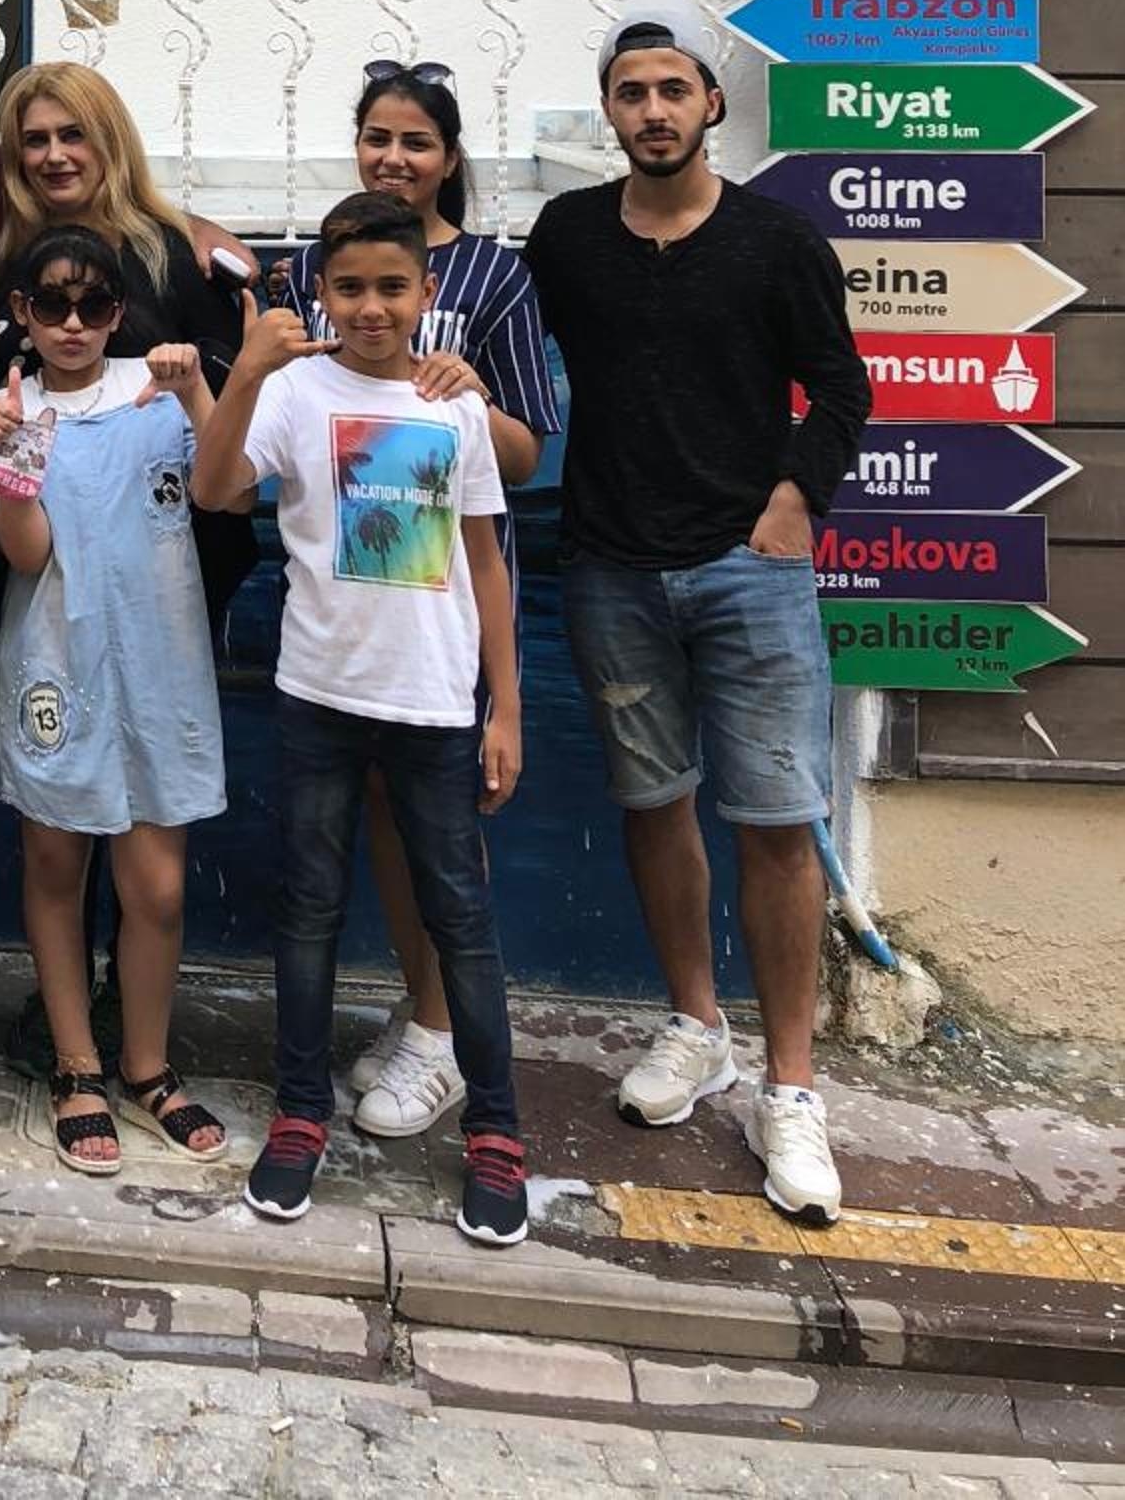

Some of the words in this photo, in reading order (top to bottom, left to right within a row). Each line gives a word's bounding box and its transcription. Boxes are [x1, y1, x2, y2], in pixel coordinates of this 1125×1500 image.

[854, 33, 882, 47] km
[826, 81, 952, 128] Riyat
[903, 123, 948, 138] 3138
[952, 123, 980, 139] km
[828, 166, 967, 211] Girne
[845, 213, 890, 228] 1008
[894, 213, 922, 228] km
[846, 257, 948, 294] eina
[859, 301, 892, 316] 700
[896, 303, 948, 317] metre
[865, 355, 985, 384] msun
[843, 440, 938, 481] mir
[345, 483, 402, 501] VACATION
[864, 481, 899, 496] 468
[903, 481, 931, 496] km
[810, 526, 998, 572] Moskova
[853, 573, 881, 589] km
[828, 611, 1015, 658] pahider
[982, 657, 1010, 672] km
[35, 707, 58, 731] 13
